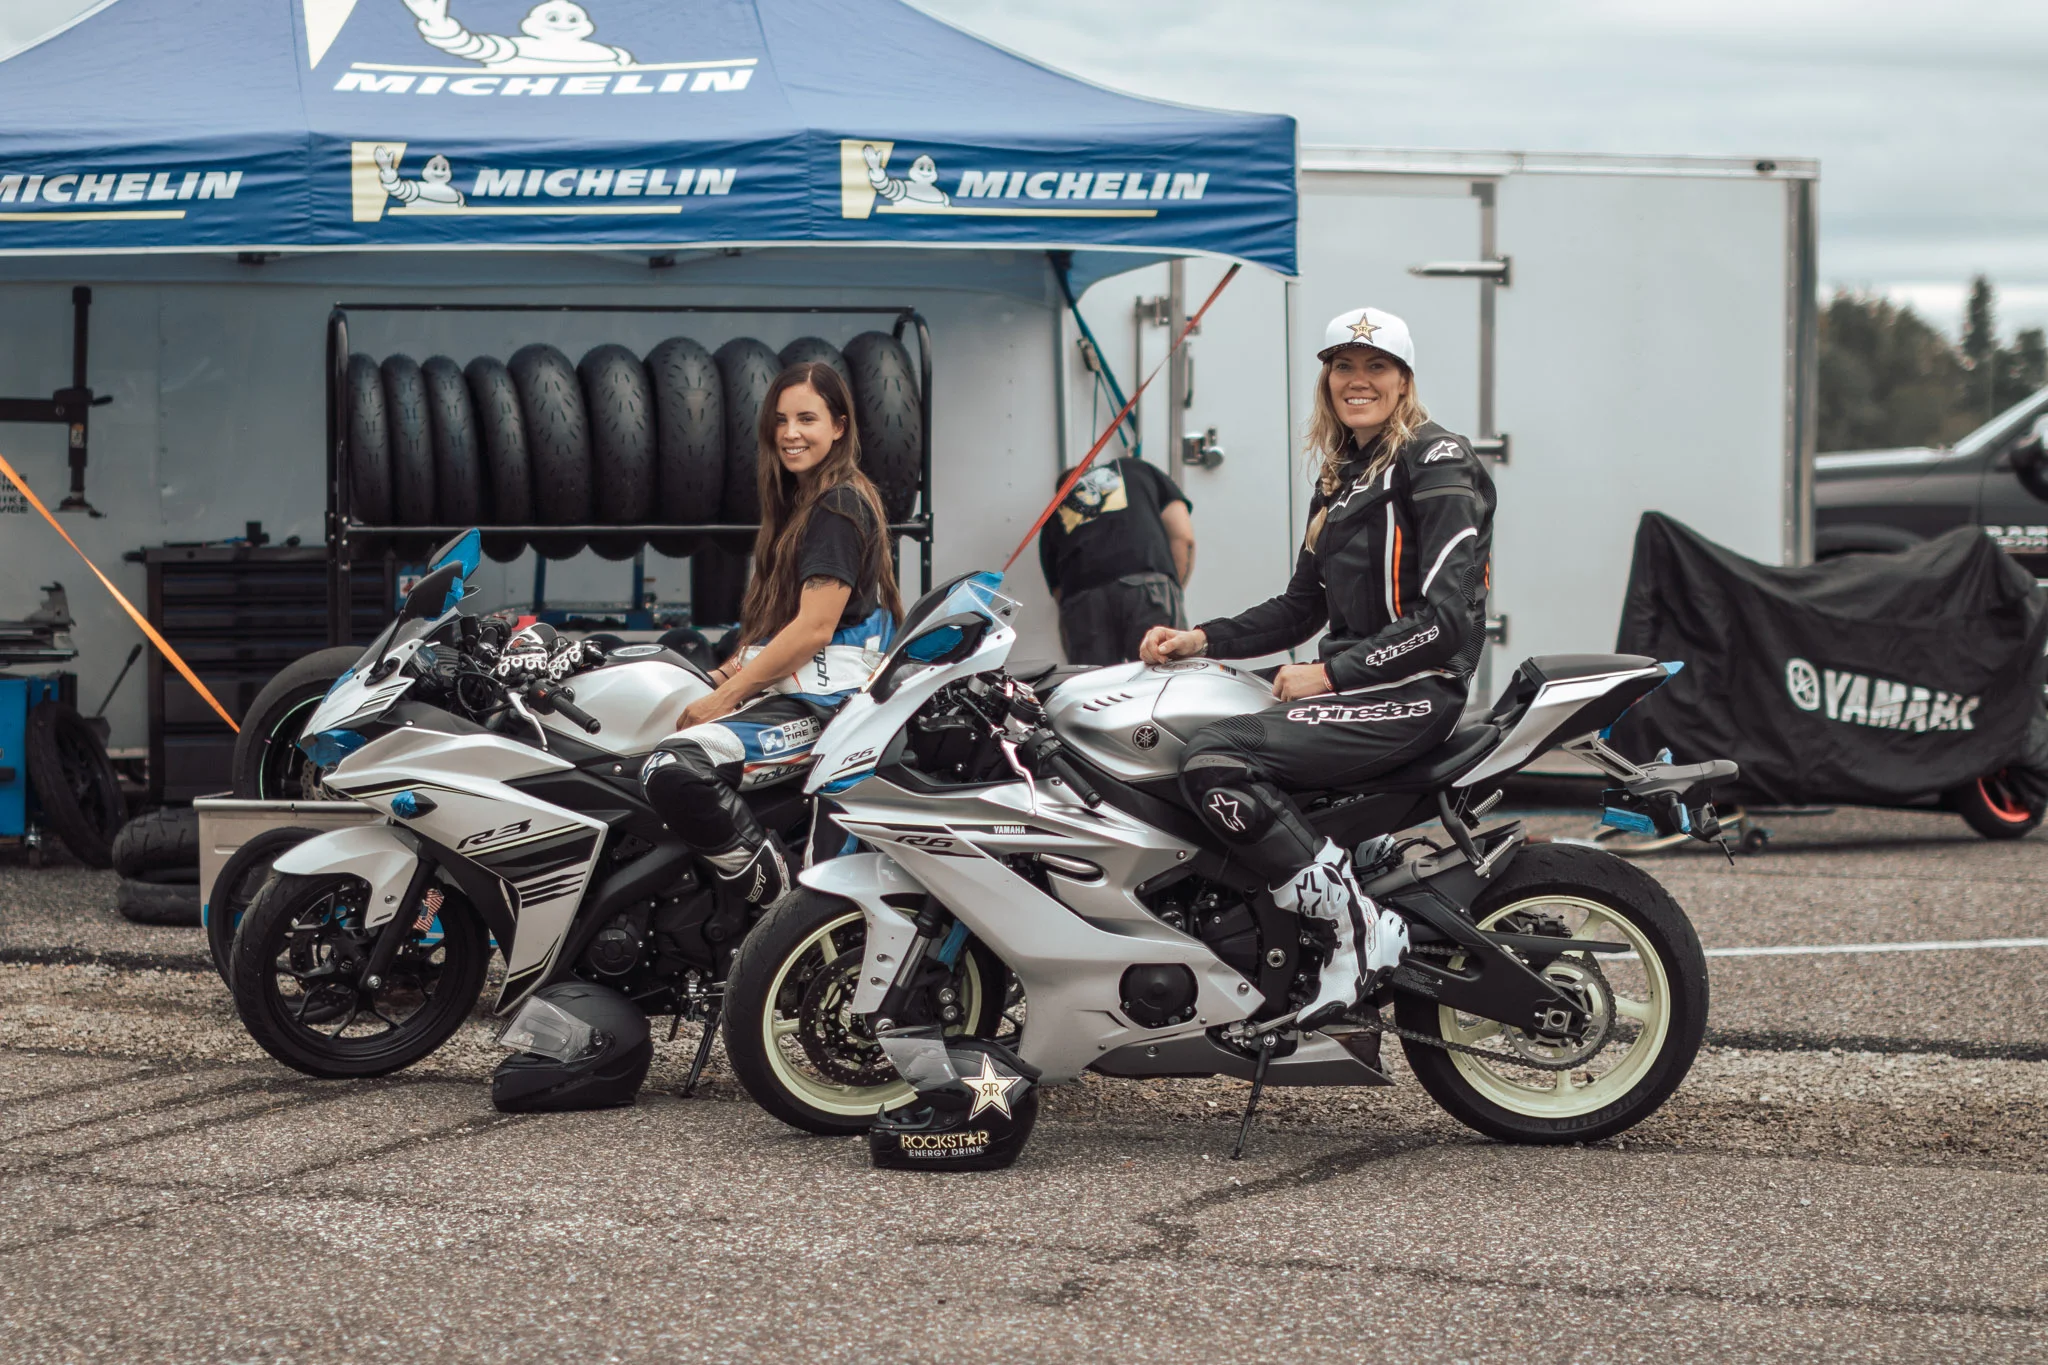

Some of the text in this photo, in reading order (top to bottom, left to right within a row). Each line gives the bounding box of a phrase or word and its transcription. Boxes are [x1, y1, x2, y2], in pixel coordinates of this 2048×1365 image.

[333, 69, 754, 96] MICHELIN
[471, 168, 737, 197] MICHELIN
[956, 171, 1209, 200] MICHELIN
[1366, 625, 1440, 666] alpinestars
[1287, 699, 1432, 725] alpinestars
[783, 717, 818, 733] SPOR
[785, 729, 809, 741] TIRE
[841, 747, 876, 765] R6
[456, 818, 532, 849] R3
[993, 825, 1026, 834] YAMAHA
[895, 835, 959, 848] R6
[909, 1146, 982, 1157] ENERGY DRINK
